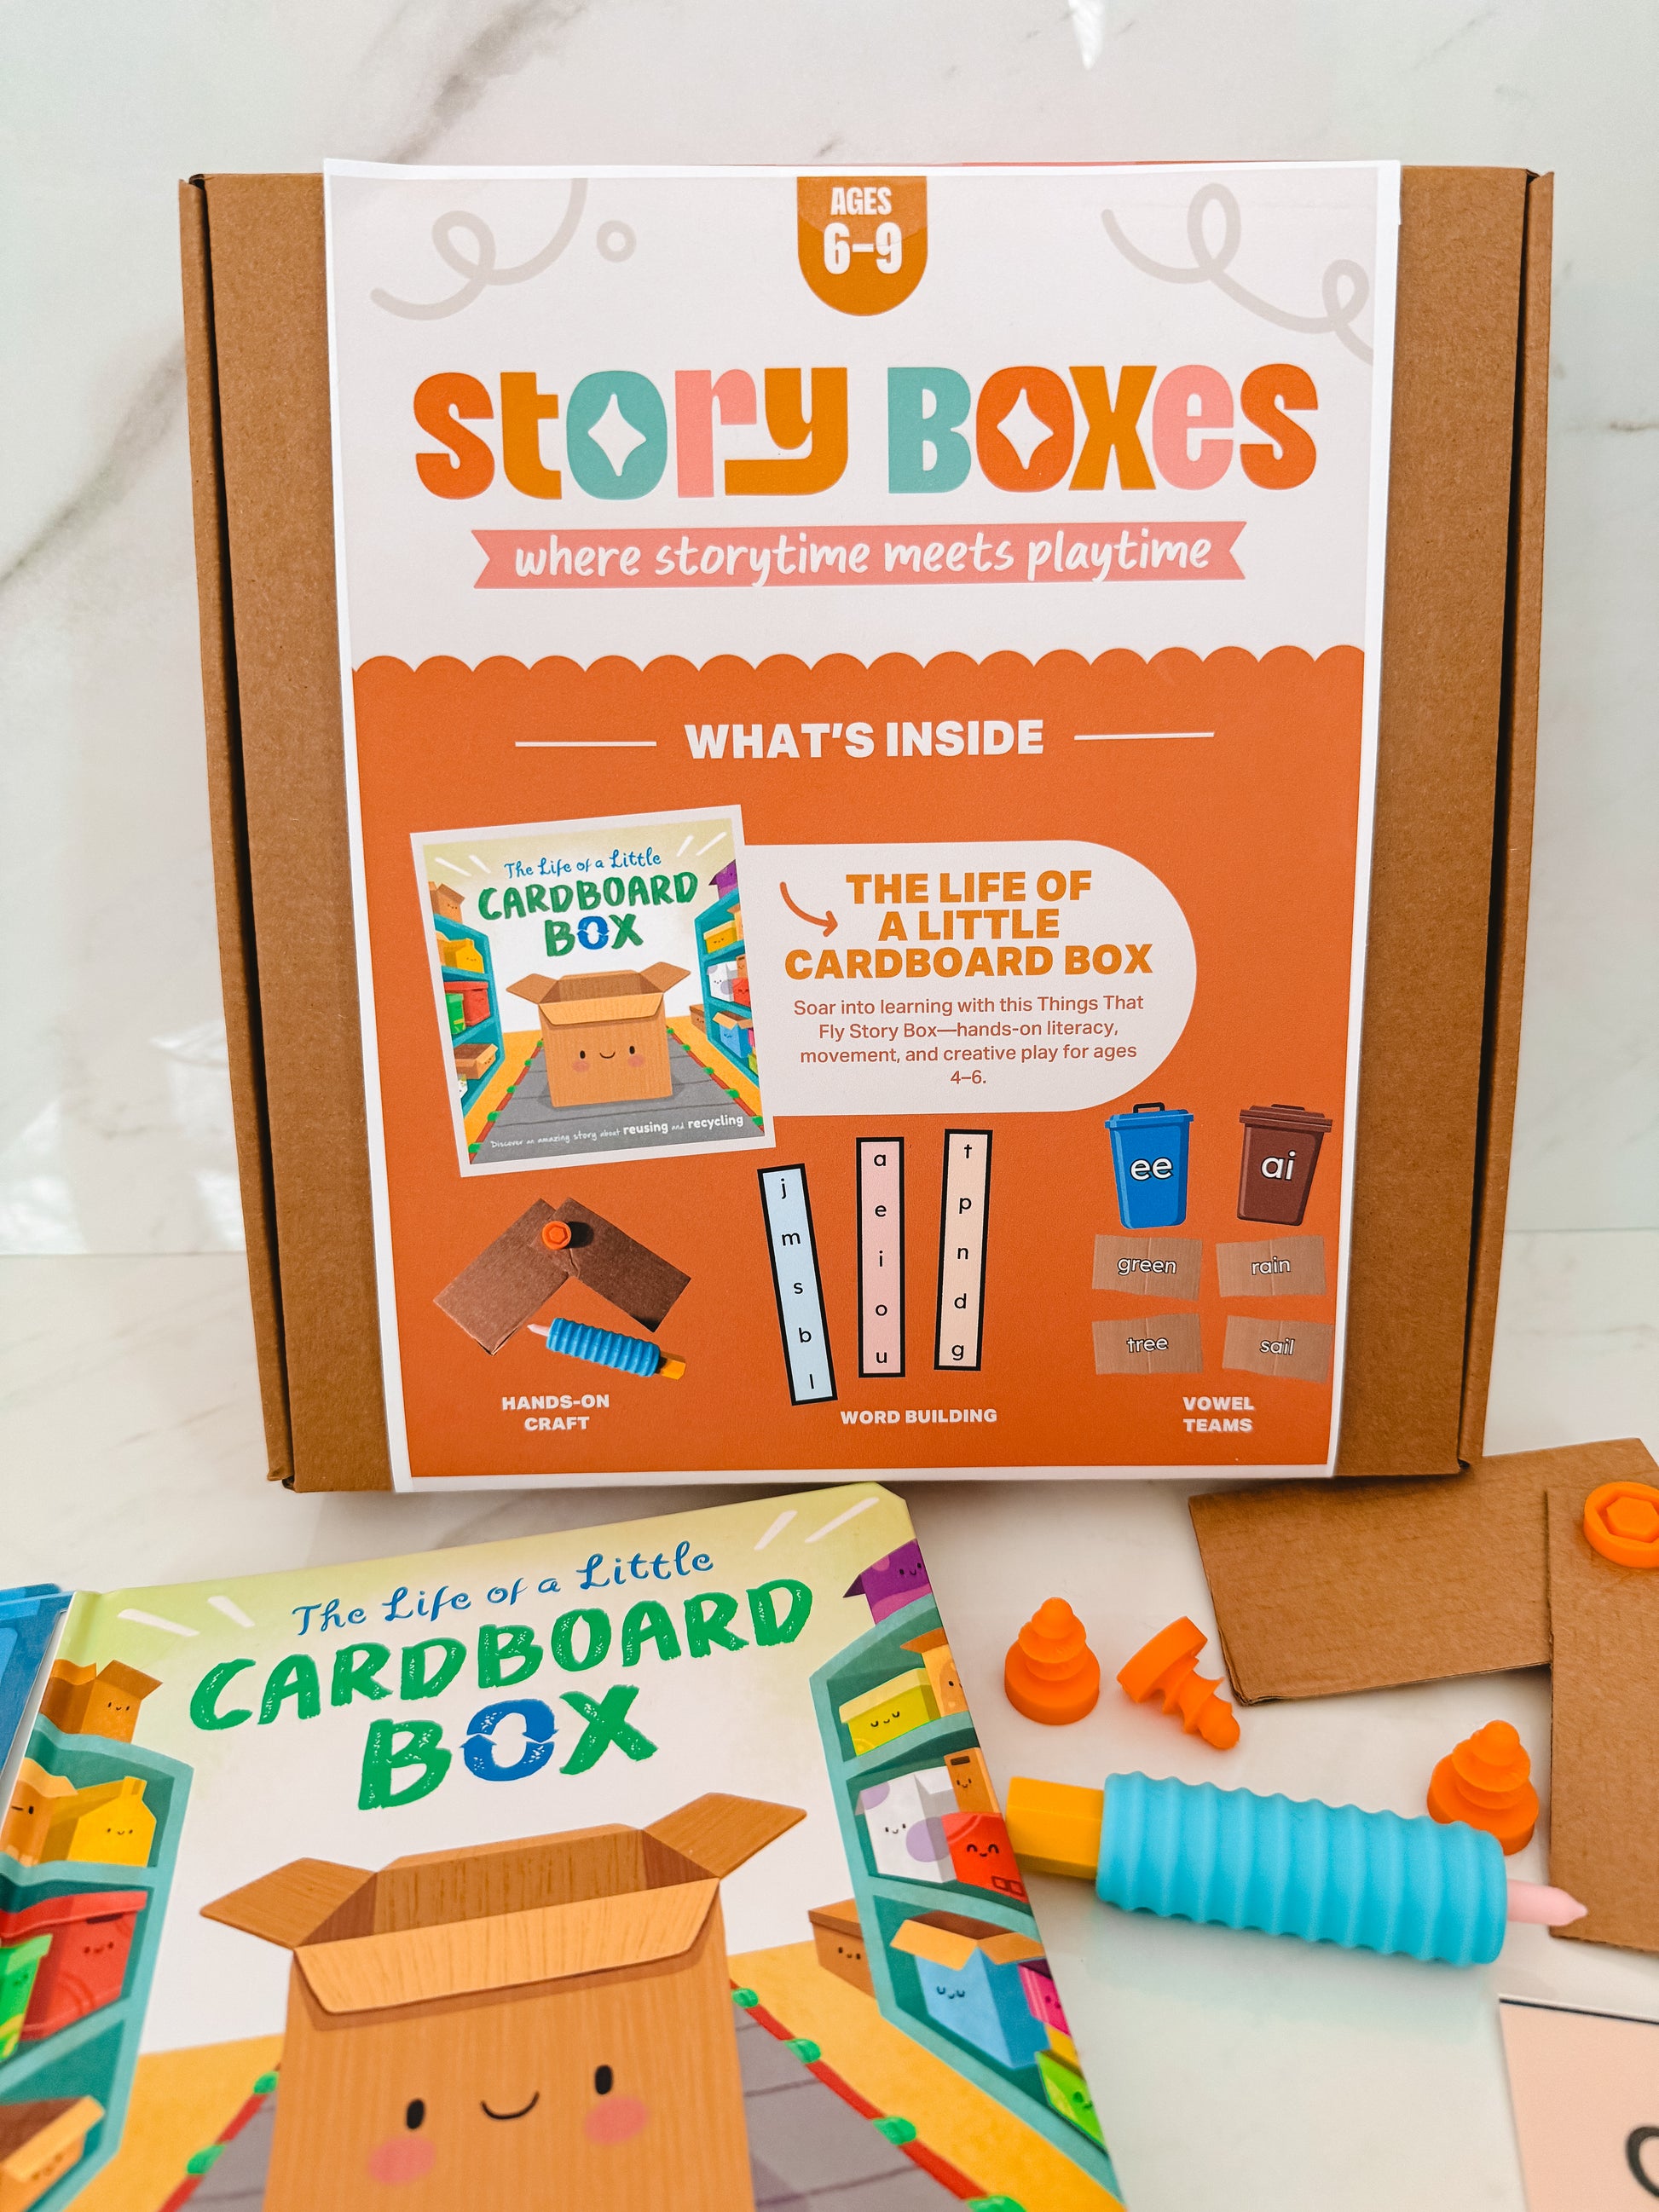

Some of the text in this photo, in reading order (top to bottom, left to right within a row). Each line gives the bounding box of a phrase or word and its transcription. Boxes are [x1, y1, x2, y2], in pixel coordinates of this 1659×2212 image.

[830, 186, 892, 217] AGES
[516, 528, 1211, 587] where storytime meets playtime
[884, 719, 1044, 758] INSIDE
[504, 861, 534, 879] The
[538, 858, 571, 877] Life
[576, 858, 592, 872] of
[610, 846, 662, 868] Little
[477, 871, 698, 921] CARDBOARD
[846, 870, 1091, 904] THE LIFE OF
[544, 913, 644, 956] BOX
[878, 909, 1060, 941] A LITTLE
[784, 944, 1153, 980] CARDBOARD BOX
[794, 995, 1143, 1016] Soar into learning with this Things That
[819, 1024, 845, 1041] Fly
[849, 1023, 899, 1041] Story
[1047, 1020, 1119, 1038] literacy,
[801, 1044, 1137, 1064] movement, and creative play for ages
[490, 1139, 523, 1147] Discover
[537, 1134, 569, 1144] amazing
[574, 1130, 597, 1141] story
[600, 1129, 621, 1138] about
[623, 1121, 668, 1135] reusing
[688, 1115, 743, 1129] recycling
[874, 1153, 887, 1166] a
[1130, 1156, 1173, 1181] ee
[1261, 1150, 1296, 1181] ai
[875, 1204, 887, 1217] e
[879, 1250, 883, 1267] i
[951, 1144, 973, 1360] t p n d g
[1117, 1256, 1177, 1276] green
[1251, 1256, 1291, 1276] rain
[781, 1232, 801, 1246] m
[798, 1327, 812, 1343] b
[876, 1351, 887, 1363] u
[1126, 1336, 1169, 1353] tree
[1260, 1338, 1295, 1355] sail
[501, 1395, 610, 1411] HANDS-ON
[1182, 1396, 1255, 1412] VOWEL
[524, 1417, 589, 1431] CRAFT
[841, 1408, 997, 1424] WORD BUILDING
[1183, 1418, 1253, 1433] TEAMS
[292, 1540, 714, 1636] The Life of a Little
[187, 1577, 815, 1733] CARDBOARD
[356, 1684, 660, 1811] BOX
